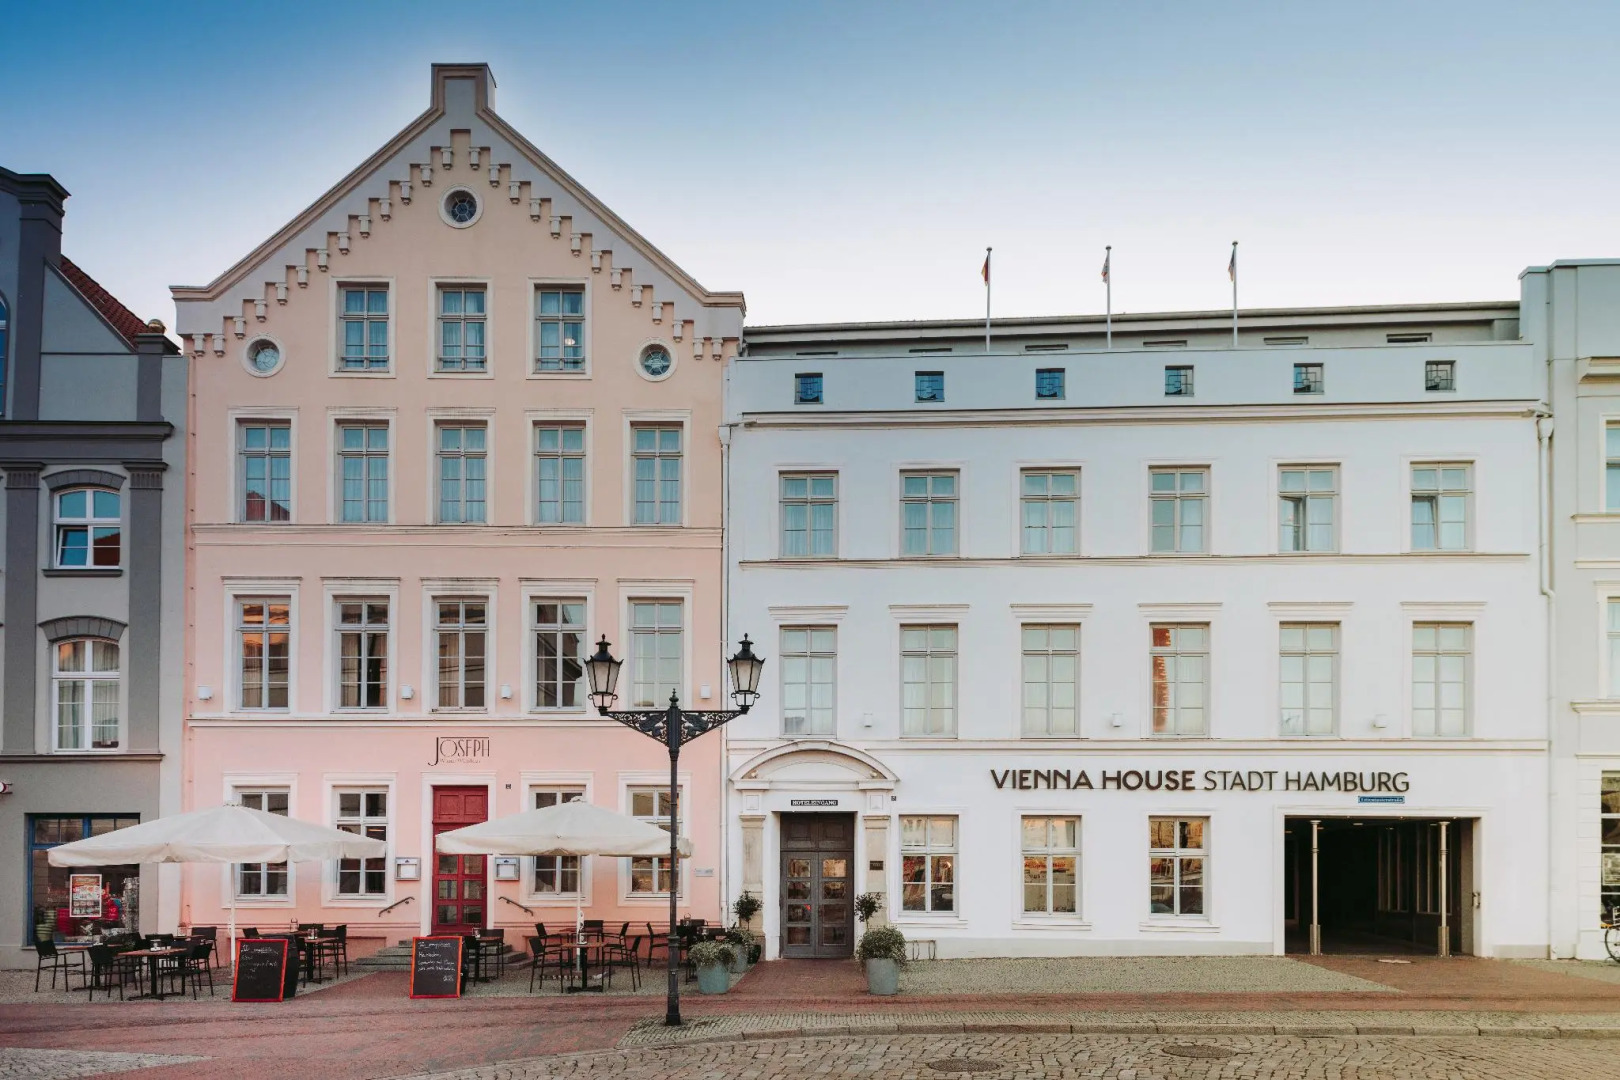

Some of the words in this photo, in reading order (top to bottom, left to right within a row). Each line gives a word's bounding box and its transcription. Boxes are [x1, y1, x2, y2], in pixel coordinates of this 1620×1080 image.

[990, 769, 1094, 790] VIENNA
[1102, 770, 1196, 791] HOUSE
[1203, 770, 1278, 792] STADT
[1284, 771, 1410, 793] HAMBURG
